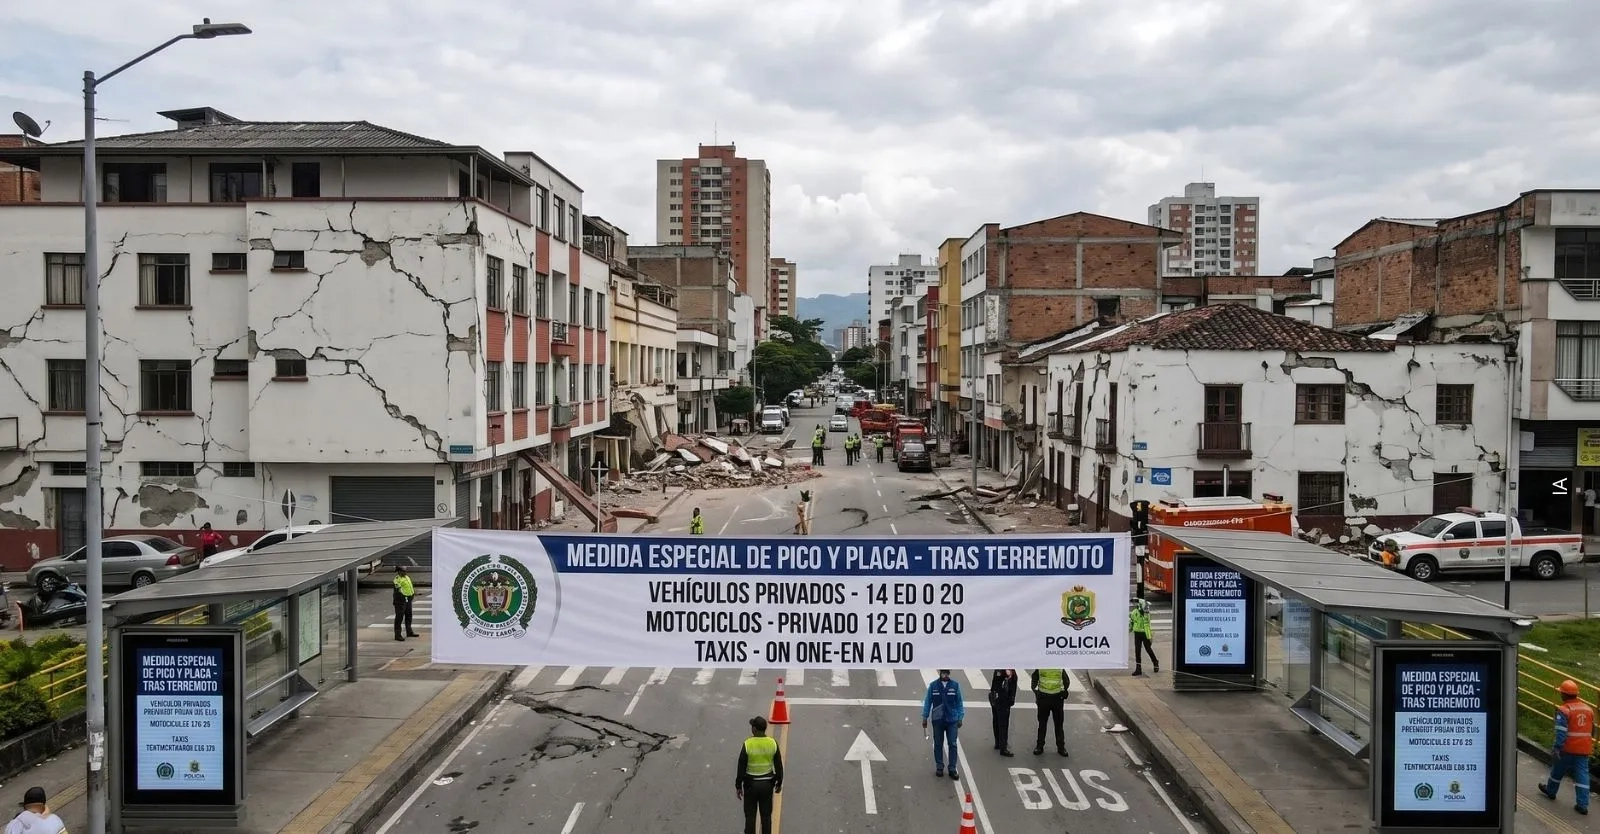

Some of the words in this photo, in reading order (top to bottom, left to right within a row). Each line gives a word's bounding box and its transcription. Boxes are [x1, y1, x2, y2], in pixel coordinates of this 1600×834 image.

[567, 543, 643, 568] MEDIDA
[650, 544, 741, 569] ESPECIAL
[747, 545, 771, 569] DE
[778, 545, 822, 570] PICO
[828, 546, 841, 570] Y
[846, 546, 909, 570] PLACA
[928, 545, 979, 570] TRAS
[985, 545, 1104, 570] TERREMOTO
[1190, 571, 1213, 580] MEDIDA
[1214, 571, 1242, 580] ESPECIAL
[1190, 580, 1198, 588] DE
[1199, 580, 1213, 588] PICO
[1213, 580, 1218, 588] Y
[1218, 580, 1237, 588] PLACA
[649, 577, 750, 604] VEHÍCULOS
[755, 582, 845, 605] PRIVADOS
[866, 583, 888, 605] 14
[894, 583, 916, 605] ED
[940, 583, 964, 605] 20
[1190, 589, 1206, 597] TRAS
[1207, 589, 1242, 597] TERREMOTO
[646, 611, 762, 634] MOTOCICLOS
[778, 612, 859, 634] PRIVADO
[866, 612, 888, 634] 12
[894, 613, 916, 634] ED
[940, 612, 964, 634] 20
[1045, 636, 1110, 649] POLICIA
[695, 640, 748, 663] TAXIS
[766, 641, 790, 663] ON
[796, 641, 864, 663] ONE-EN
[870, 642, 882, 663] A
[143, 655, 175, 666] MEDIDA
[177, 655, 217, 666] ESPECIAL
[143, 668, 154, 679] DE
[156, 668, 175, 679] PICO
[177, 668, 182, 679] Y
[184, 668, 211, 679] PLACA
[1402, 671, 1437, 682] MEDIDA
[1439, 671, 1480, 682] ESPECIAL
[143, 680, 165, 691] TRAS
[167, 680, 218, 691] TERREMOTO
[1402, 684, 1413, 695] DE
[1415, 684, 1436, 695] PICO
[1438, 684, 1444, 695] Y
[1446, 684, 1474, 695] PLACA
[1402, 697, 1425, 708] TRAS
[1427, 697, 1480, 708] TERREMOTO
[1432, 754, 1450, 762] TAXIS
[1008, 767, 1129, 812] BUS
